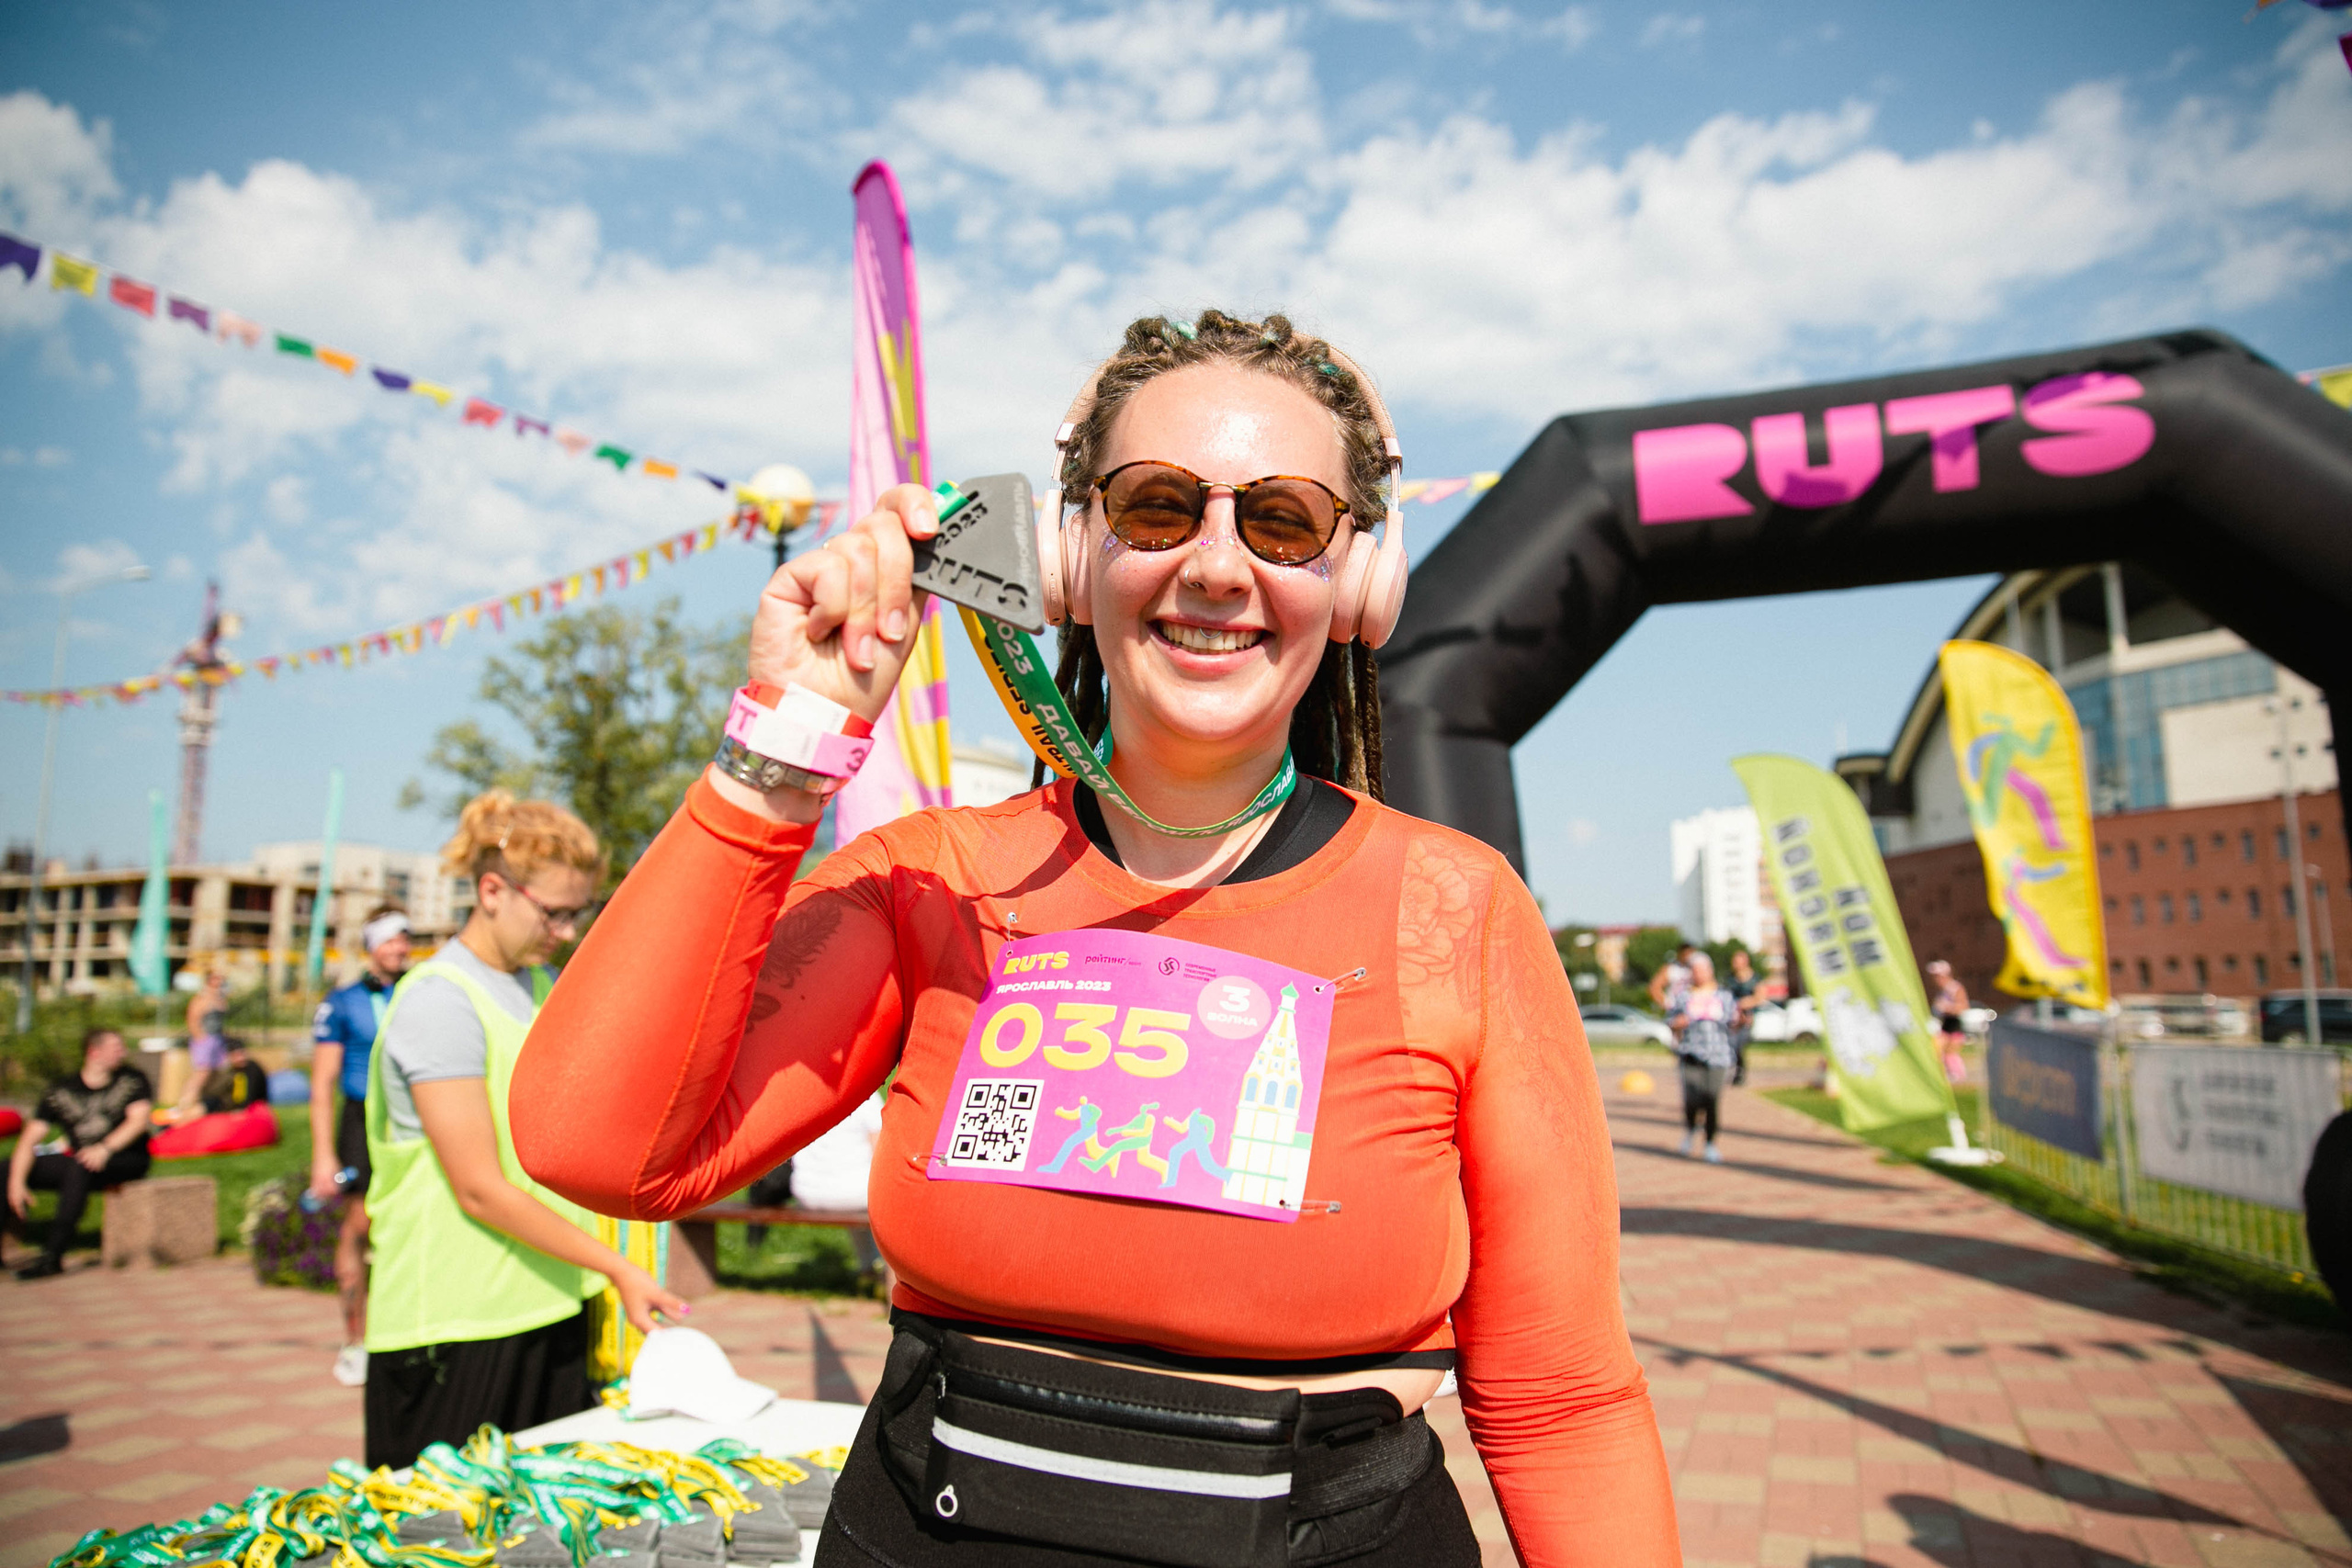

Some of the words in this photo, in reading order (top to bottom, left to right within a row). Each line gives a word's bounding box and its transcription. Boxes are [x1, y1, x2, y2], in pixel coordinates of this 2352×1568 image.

[1633, 371, 2155, 525] RUTS
[933, 502, 988, 549] 2023
[991, 615, 1035, 675] 023
[1035, 703, 1110, 789] ДАВАЙ
[996, 979, 1074, 994] ЯРОСЛАВЛЬ
[1075, 979, 1112, 991] 2023
[1003, 951, 1069, 975] RUTS
[1206, 1012, 1258, 1027] ВОЛНА
[1219, 985, 1250, 1012] 3
[979, 1001, 1192, 1078] 035
